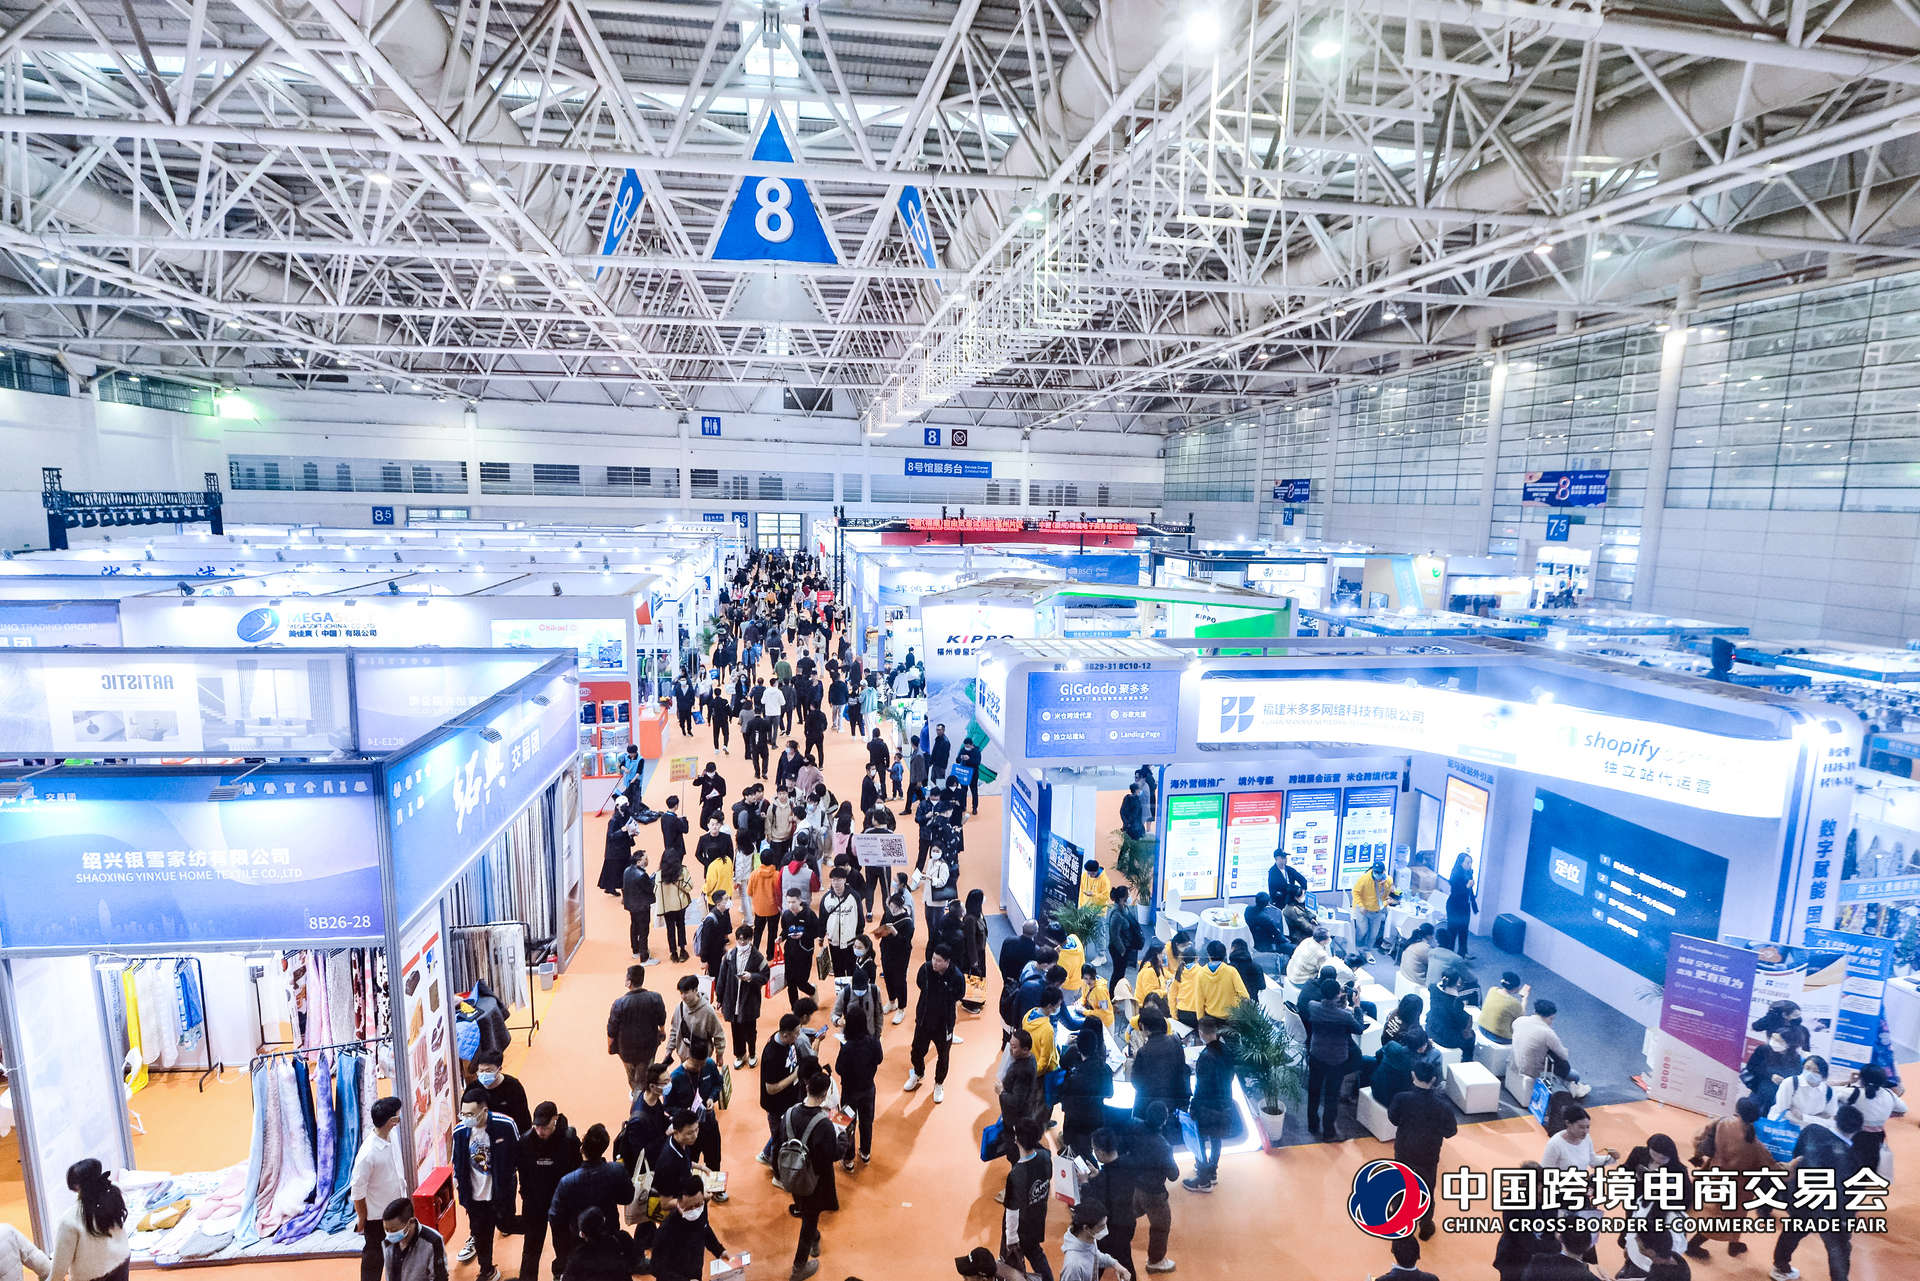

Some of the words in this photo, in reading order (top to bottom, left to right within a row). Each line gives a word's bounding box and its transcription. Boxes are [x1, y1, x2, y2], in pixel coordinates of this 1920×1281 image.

[613, 186, 634, 238] 8
[755, 177, 795, 243] 8
[907, 200, 927, 250] 8
[928, 430, 937, 444] 8
[908, 462, 963, 474] 8号馆服务台
[375, 508, 393, 522] 8.5
[1549, 519, 1567, 536] 7.5
[1195, 613, 1217, 624] KIPPO
[1263, 702, 1425, 725] 福建米多多网络科技有限公司
[1120, 731, 1145, 739] Landing
[1584, 731, 1661, 761] shopify
[1603, 760, 1713, 796] 独立站代运营
[82, 847, 290, 871] 绍兴银雪家纺有限公司
[76, 872, 134, 884] SHAOXING
[135, 871, 177, 882] YINXUE
[179, 870, 213, 881] HOME
[214, 869, 259, 880] TEXTILE
[1554, 858, 1581, 884] 定位
[309, 914, 371, 930] 8B26-28
